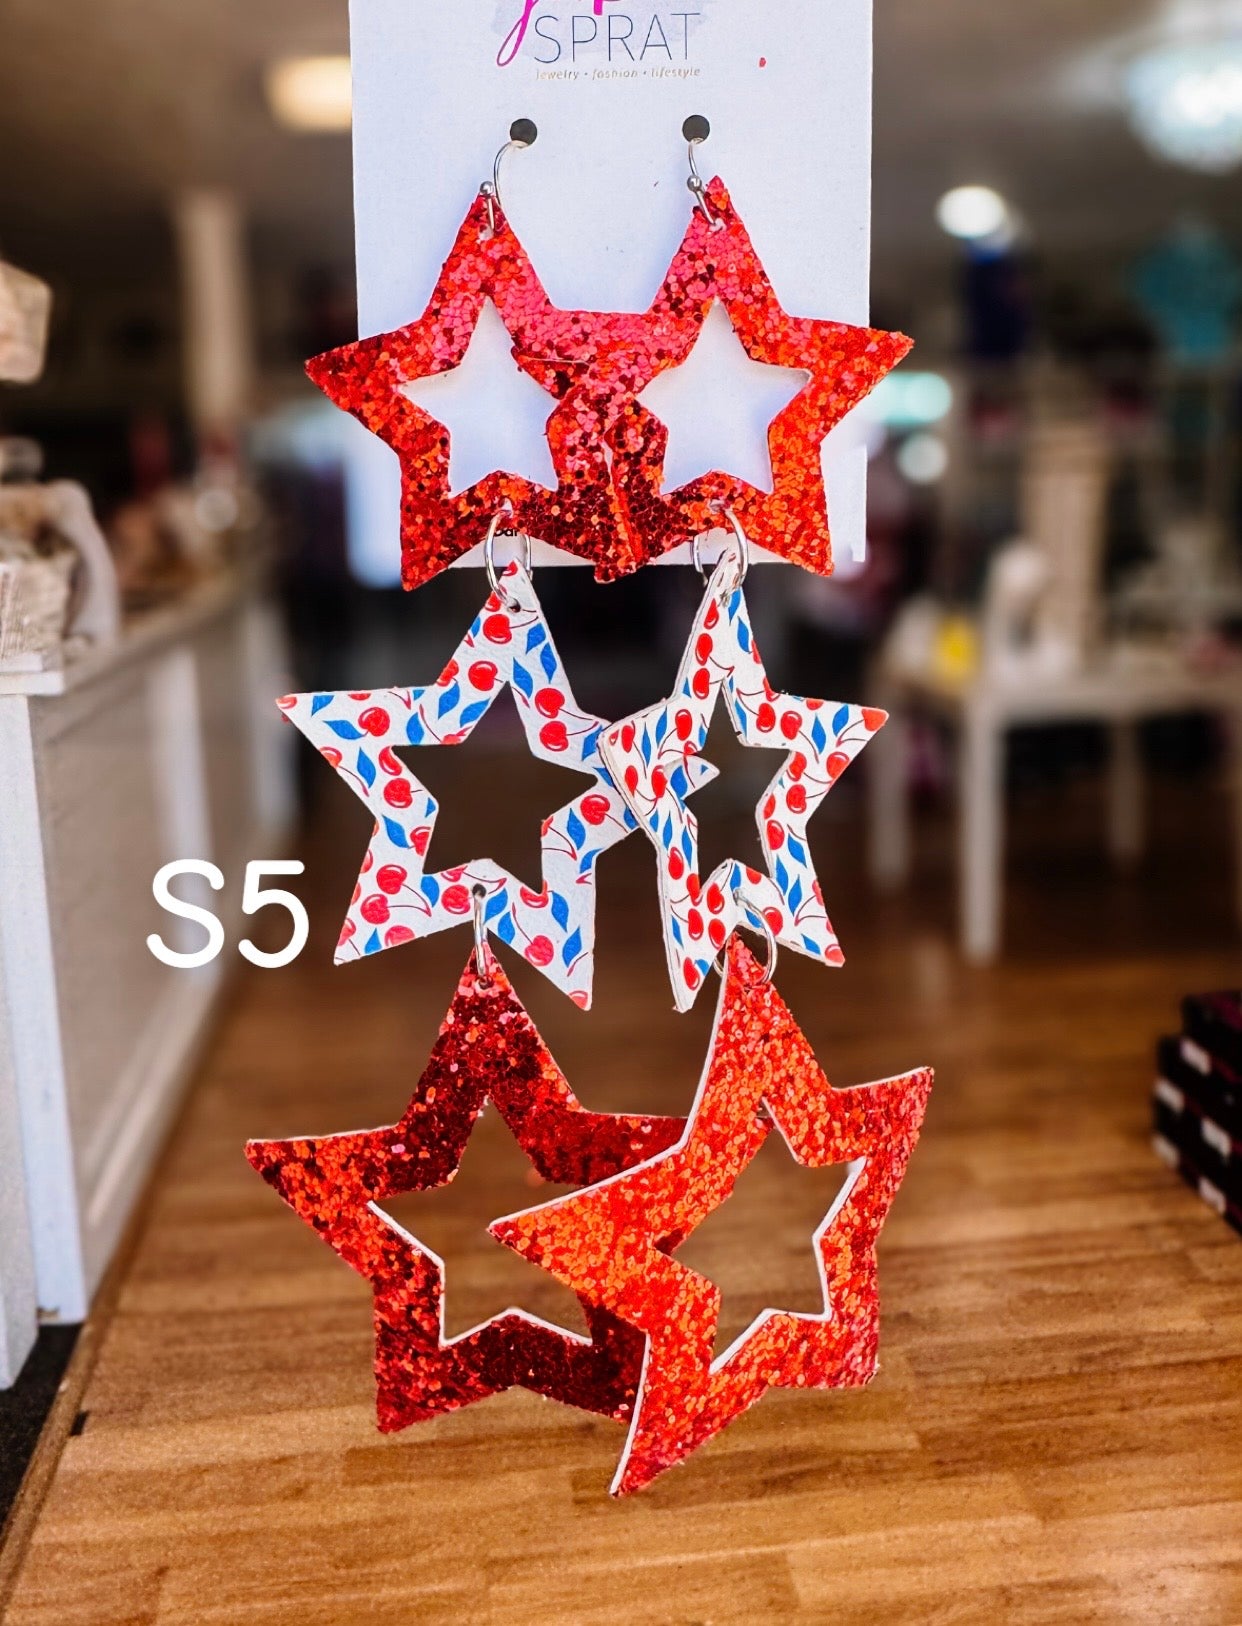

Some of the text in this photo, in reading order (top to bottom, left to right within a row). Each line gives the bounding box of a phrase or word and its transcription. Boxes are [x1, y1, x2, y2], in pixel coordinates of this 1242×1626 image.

[533, 12, 701, 64] SPRAT
[535, 66, 701, 81] jewelry fashion lifestyle
